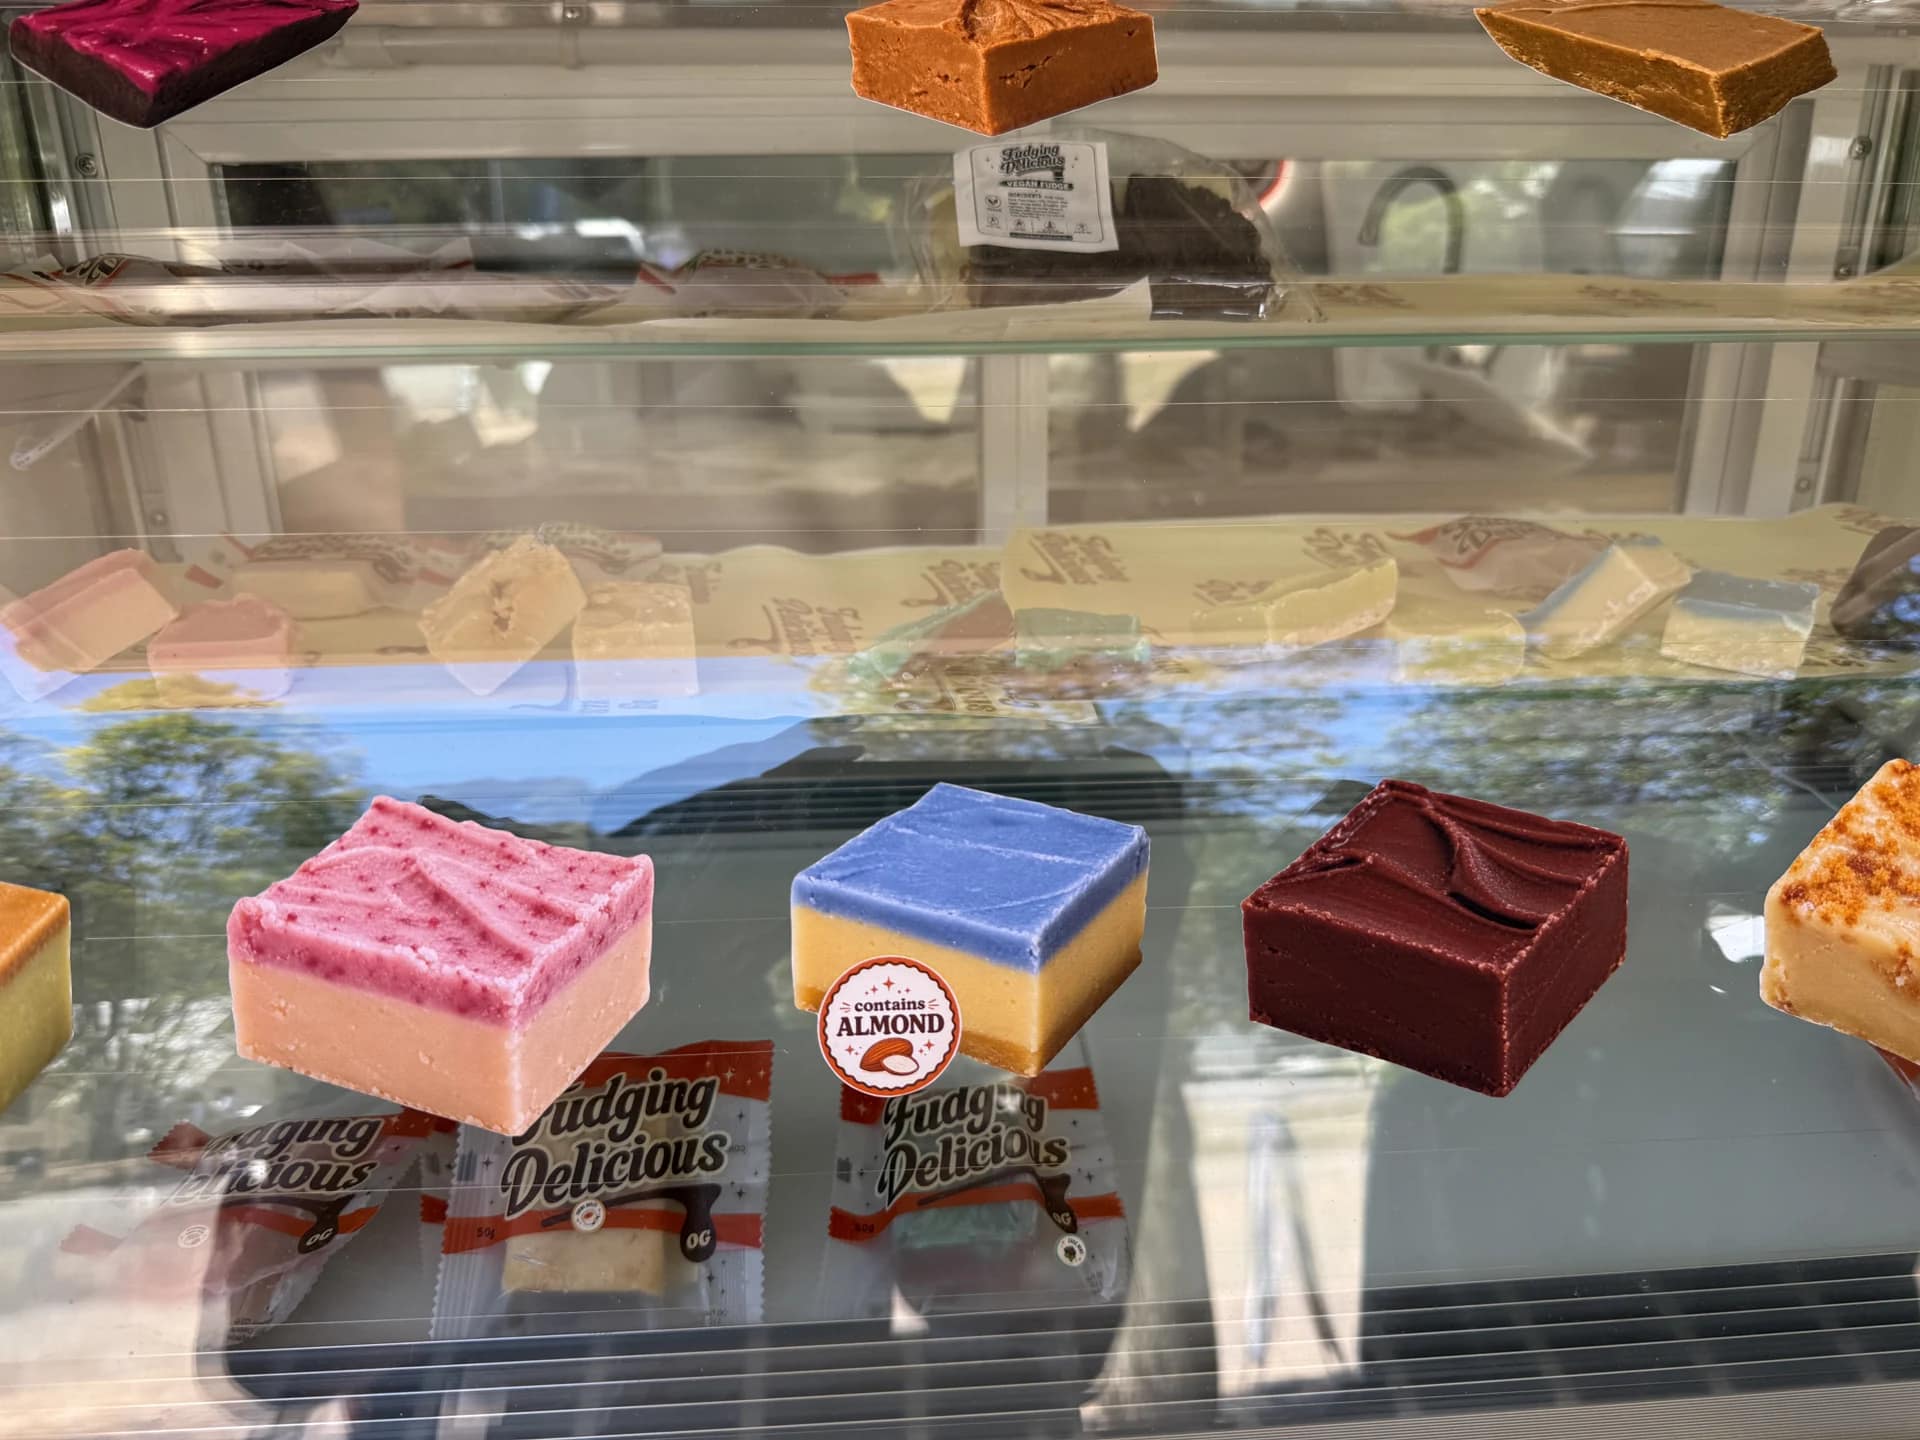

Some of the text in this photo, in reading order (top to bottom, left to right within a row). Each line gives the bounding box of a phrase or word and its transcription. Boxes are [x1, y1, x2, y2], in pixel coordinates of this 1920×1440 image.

[1001, 144, 1060, 162] Fudging
[1000, 156, 1066, 175] Delicious
[854, 998, 926, 1012] contains
[836, 1013, 945, 1037] ALMOND
[511, 1069, 718, 1147] udging
[500, 1132, 728, 1218] Delicious
[876, 1124, 1068, 1207] Delicious
[306, 1226, 333, 1246] OG
[686, 1231, 711, 1250] OG
